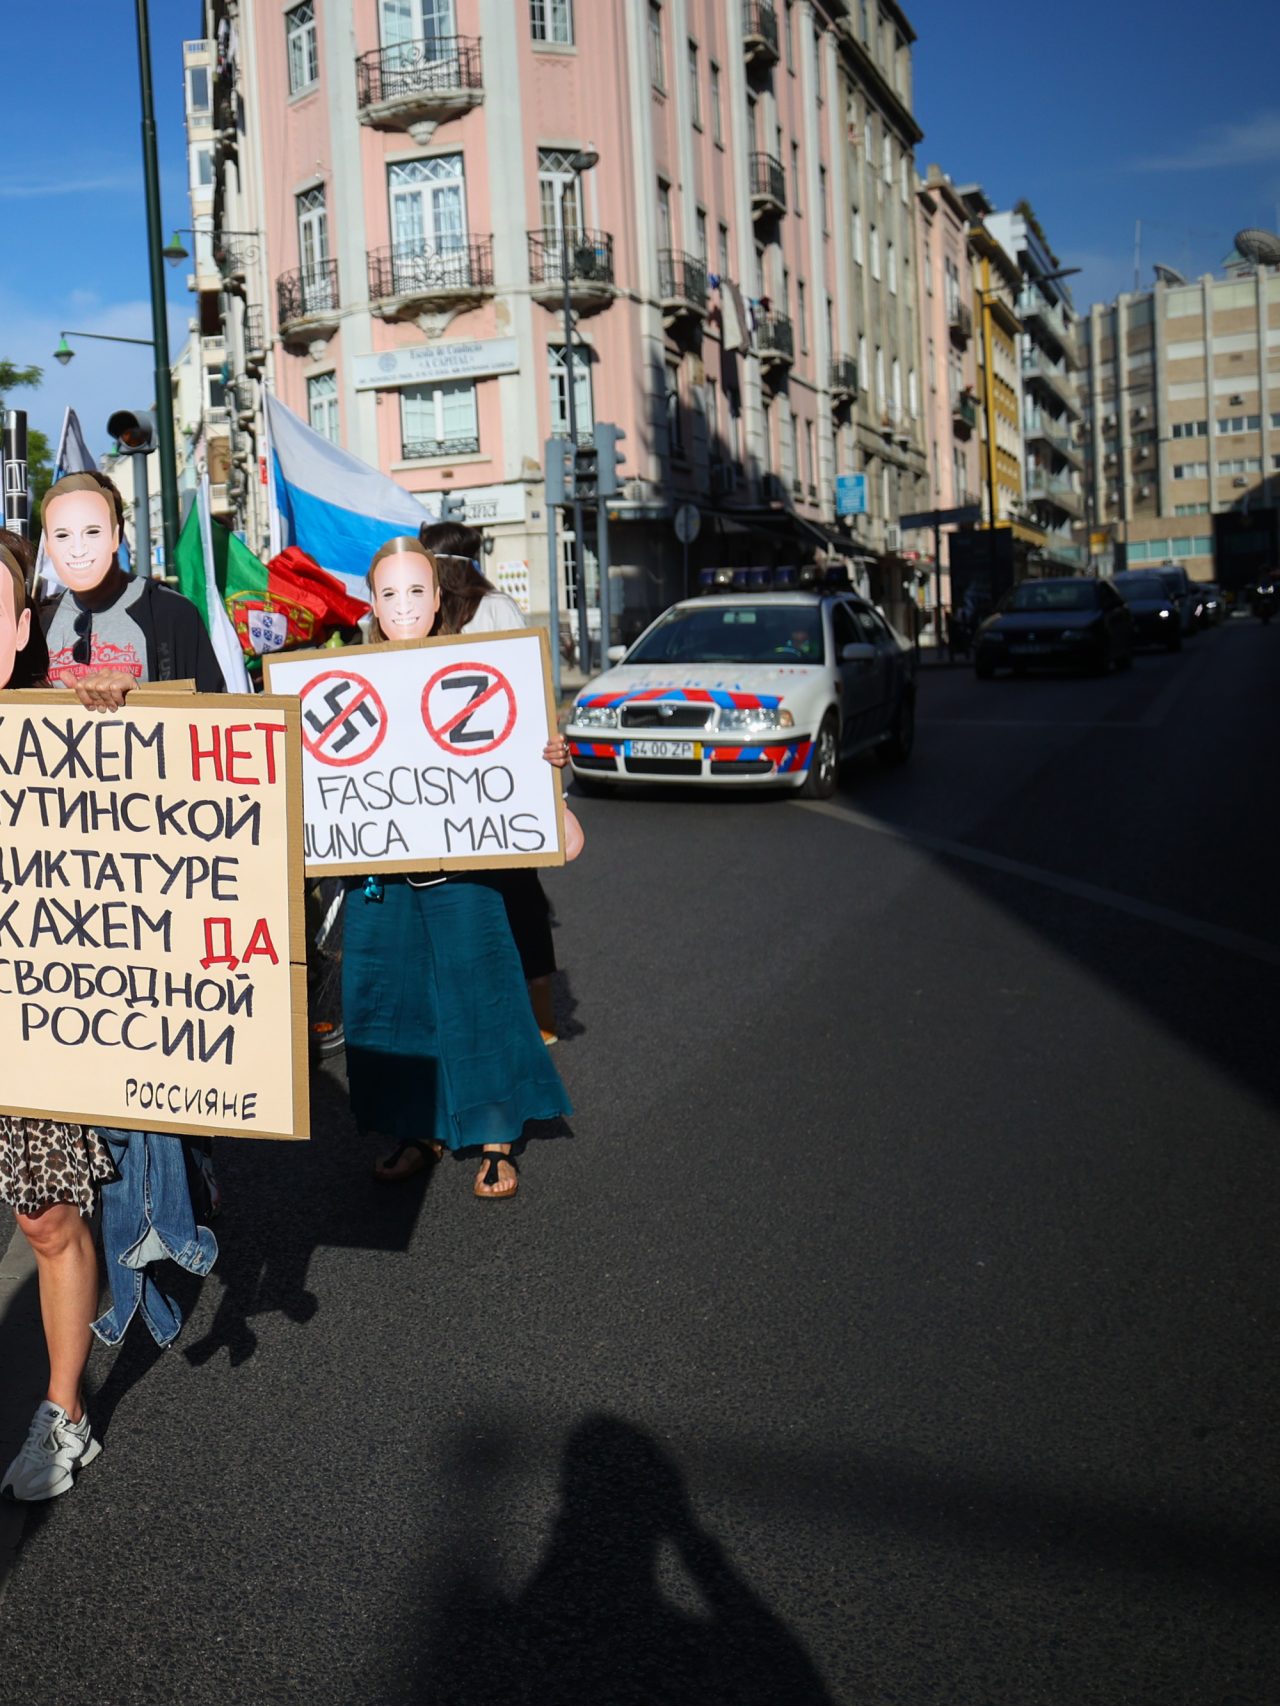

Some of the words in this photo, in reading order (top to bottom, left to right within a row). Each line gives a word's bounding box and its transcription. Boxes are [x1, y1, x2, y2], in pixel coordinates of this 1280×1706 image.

[189, 723, 288, 784] НЕТ
[317, 766, 514, 814] FASCISMO
[444, 813, 546, 852] MAIS
[200, 917, 279, 971] ДА
[21, 1003, 235, 1065] РОССИИ
[125, 1078, 258, 1121] РОССИЯНЕ
